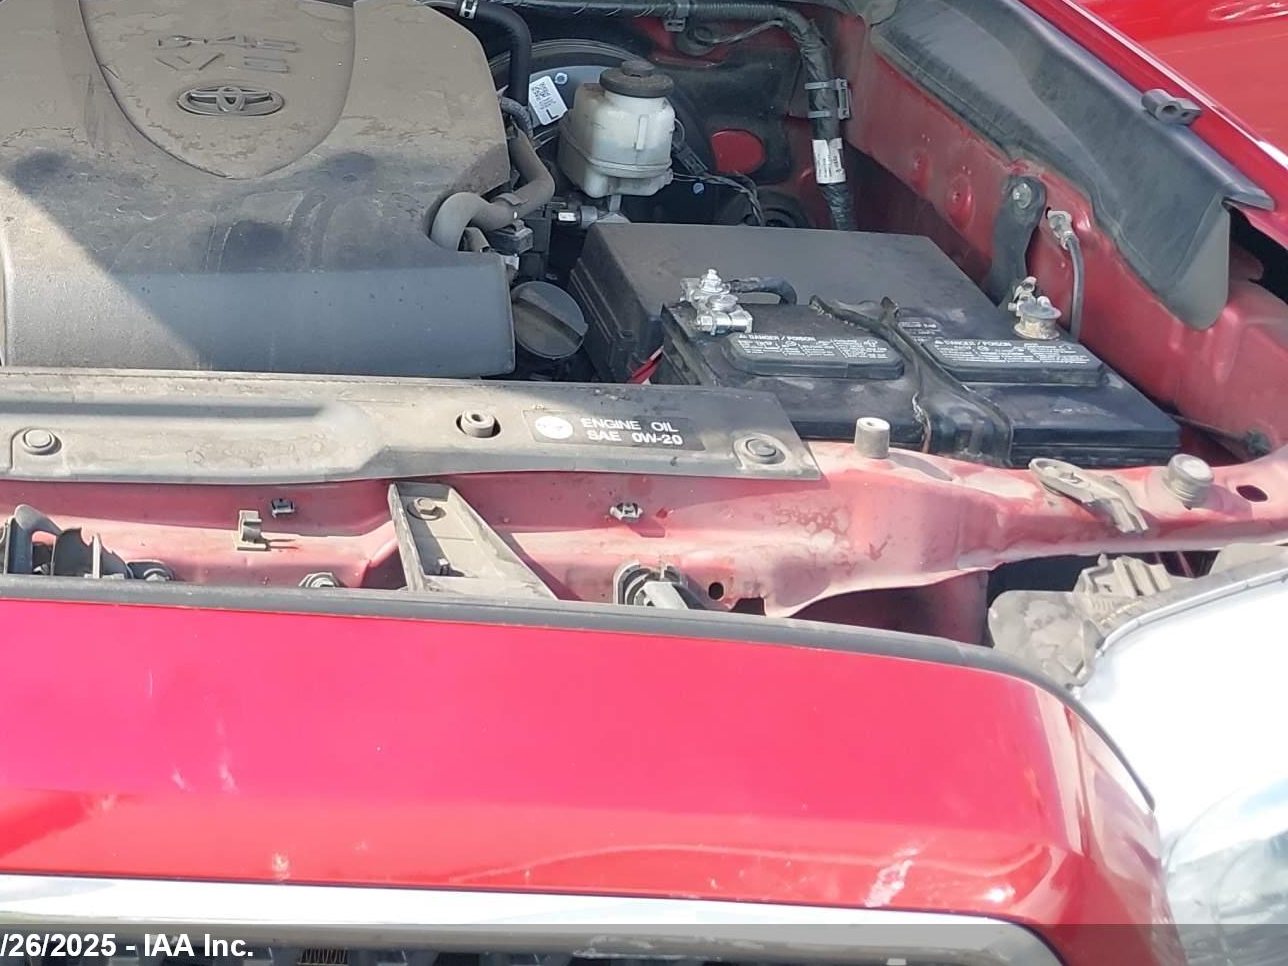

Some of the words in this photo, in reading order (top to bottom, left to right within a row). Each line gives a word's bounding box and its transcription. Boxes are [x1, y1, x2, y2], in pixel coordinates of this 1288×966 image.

[580, 418, 641, 431] ENGINE
[651, 421, 679, 433] OIL
[588, 431, 621, 441] SAE
[632, 433, 683, 445] 0W-20
